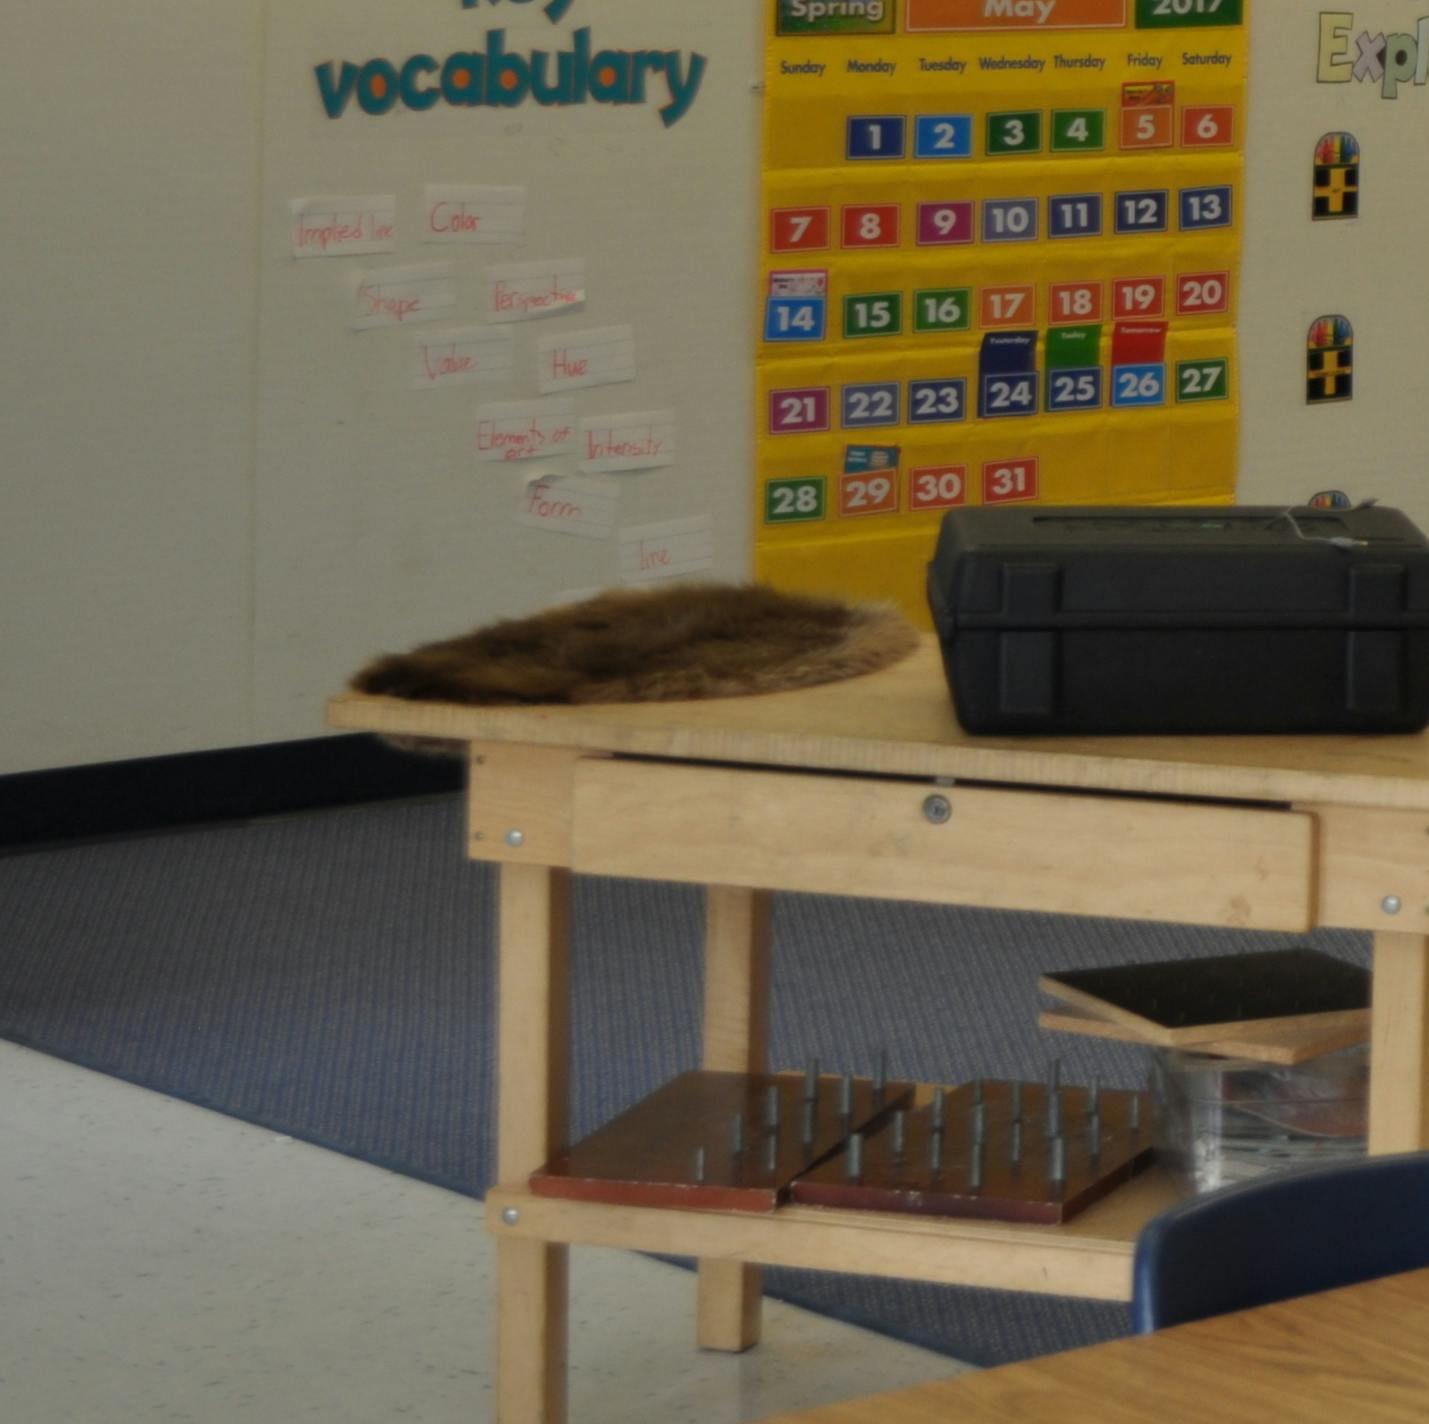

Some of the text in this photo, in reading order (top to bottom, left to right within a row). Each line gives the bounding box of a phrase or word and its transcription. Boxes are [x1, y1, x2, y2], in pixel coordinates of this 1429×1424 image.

[314, 26, 708, 128] vocabulary
[780, 51, 1232, 76] Sunday Monday Tuesday Wednesday Thursday Friday Saturday
[866, 113, 1219, 150] 1 2 3 4 5 6
[429, 200, 483, 233] Color
[789, 195, 1222, 243] 7 8 9 10 11 12 13
[776, 280, 1223, 333] 14 15 16 17 18 19 20
[989, 335, 1031, 347] Yesterday
[1119, 325, 1162, 336] Tomorrow
[552, 348, 589, 379] Hue
[779, 367, 1223, 425] 21 22 23 24 25 26 27
[528, 484, 583, 519] Form
[772, 466, 1027, 515] 28 29 30 31
